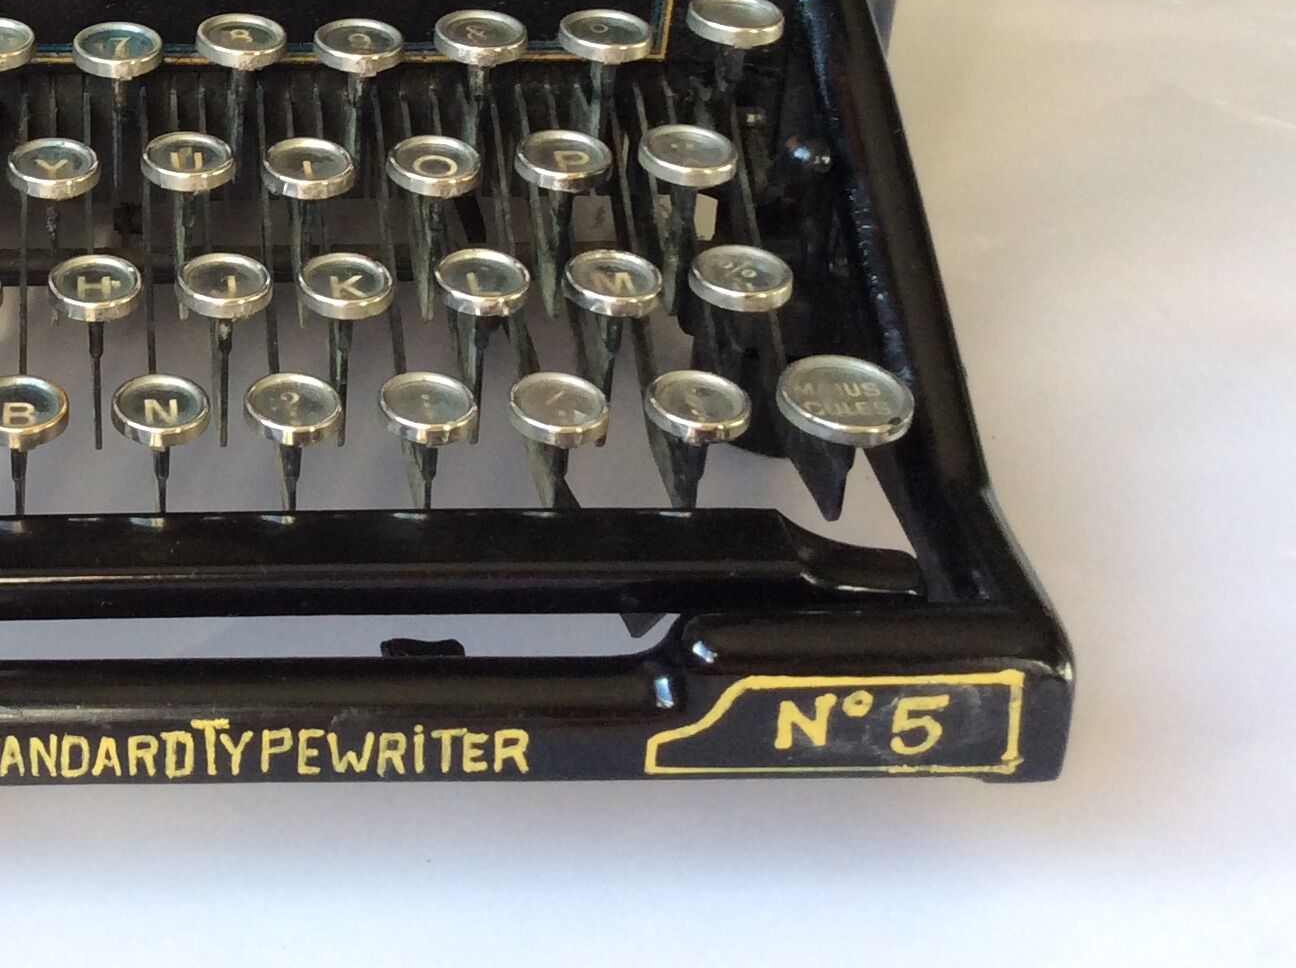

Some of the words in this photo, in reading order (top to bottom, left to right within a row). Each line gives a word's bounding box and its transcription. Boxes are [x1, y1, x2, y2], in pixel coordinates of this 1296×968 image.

[110, 36, 134, 57] 7
[229, 29, 252, 44] 8
[34, 158, 70, 180] Y
[411, 154, 459, 177] O
[552, 149, 592, 172] P
[76, 275, 114, 299] H
[329, 275, 368, 299] K
[590, 271, 638, 295] M
[2, 402, 35, 427] B
[143, 398, 178, 425] N
[890, 693, 951, 756] 5
